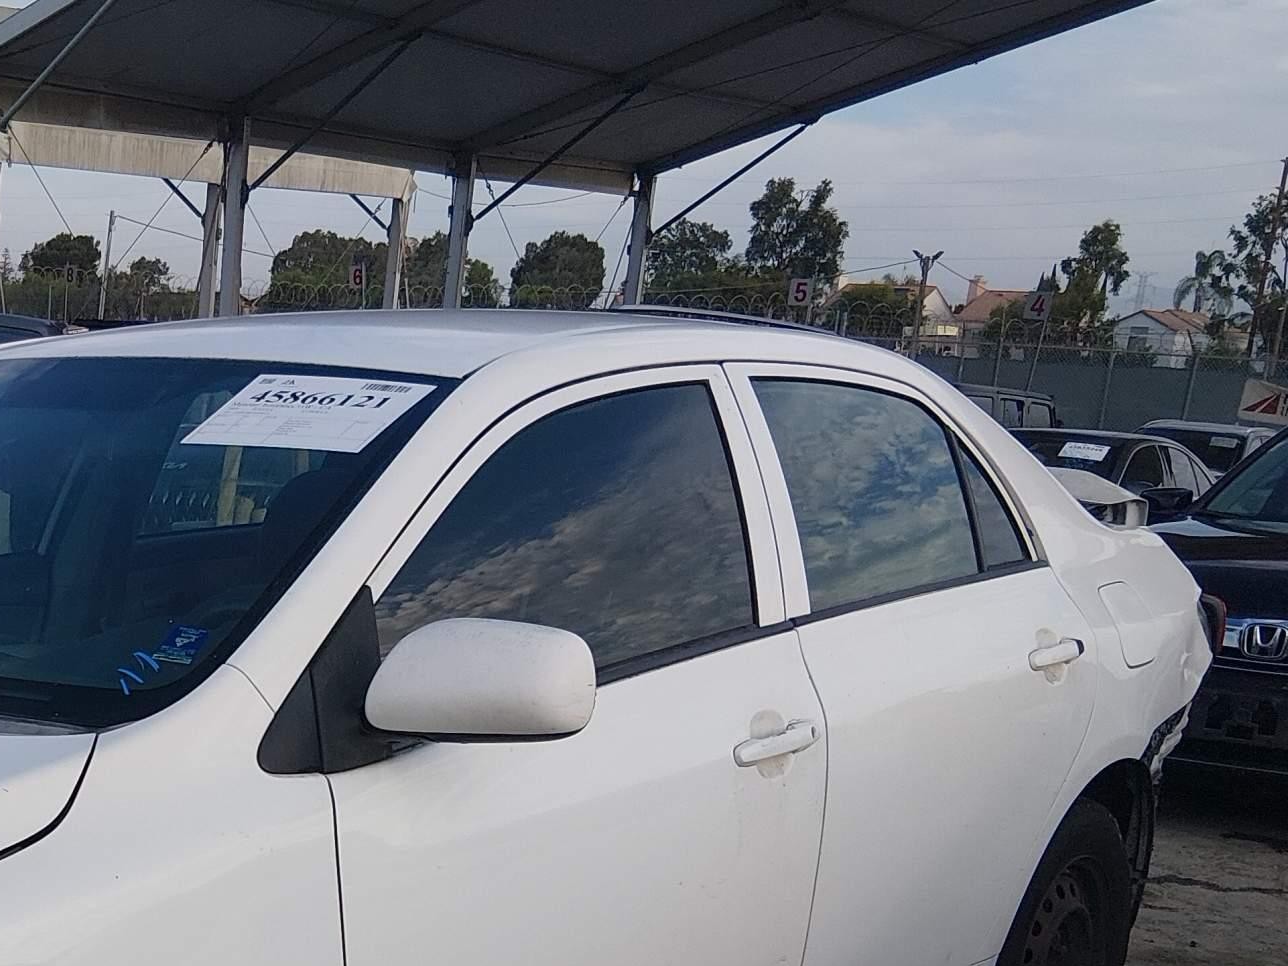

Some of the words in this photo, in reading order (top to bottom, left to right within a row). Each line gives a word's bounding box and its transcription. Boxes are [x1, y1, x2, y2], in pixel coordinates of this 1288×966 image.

[66, 267, 74, 283] 8
[353, 268, 363, 286] 6
[792, 281, 808, 303] 5
[1030, 294, 1046, 316] 4
[249, 390, 393, 409] 45866121
